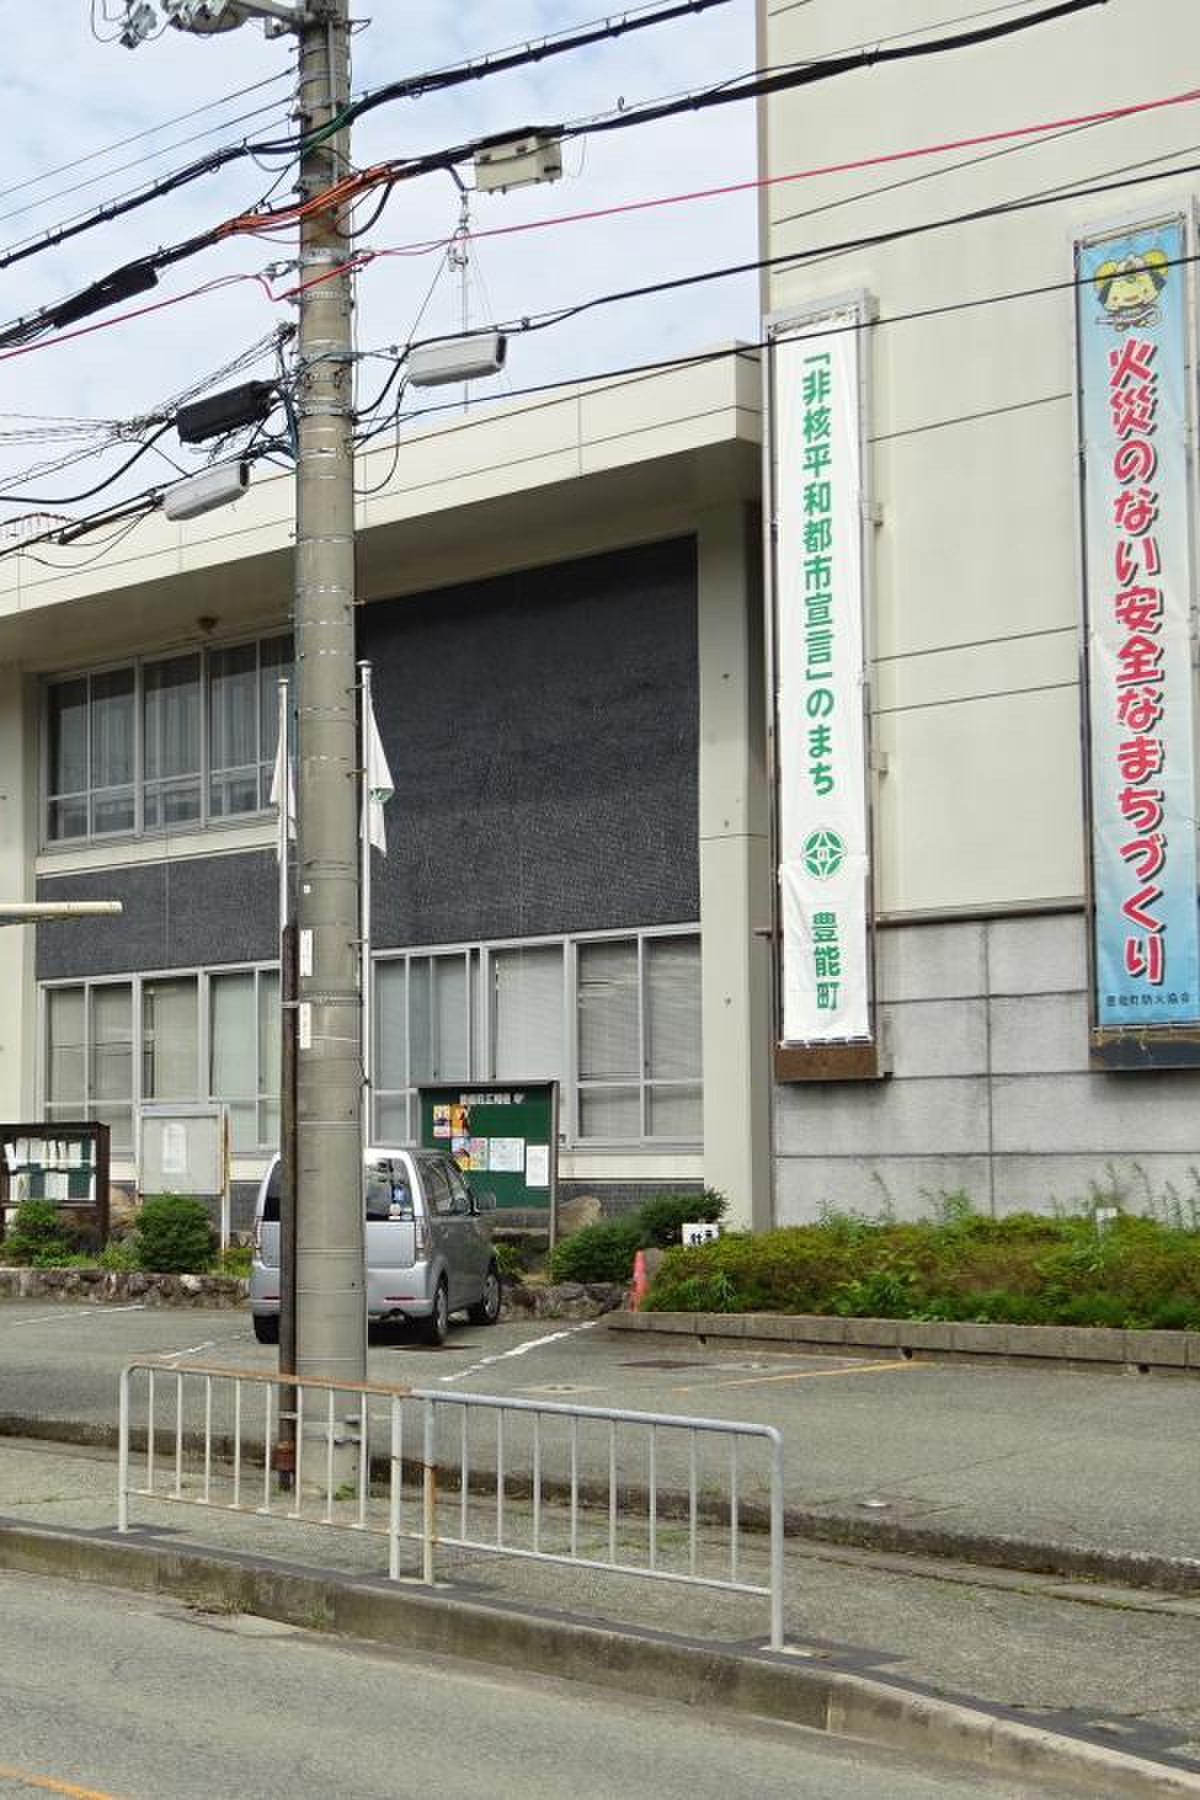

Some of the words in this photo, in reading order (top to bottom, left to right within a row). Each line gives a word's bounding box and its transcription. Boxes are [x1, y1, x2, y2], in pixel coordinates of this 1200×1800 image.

[802, 352, 834, 797] 「非核平和都市宣言」のまち
[1108, 338, 1167, 985] 火災のない安全なまちづくり
[811, 911, 841, 1011] 豊能町
